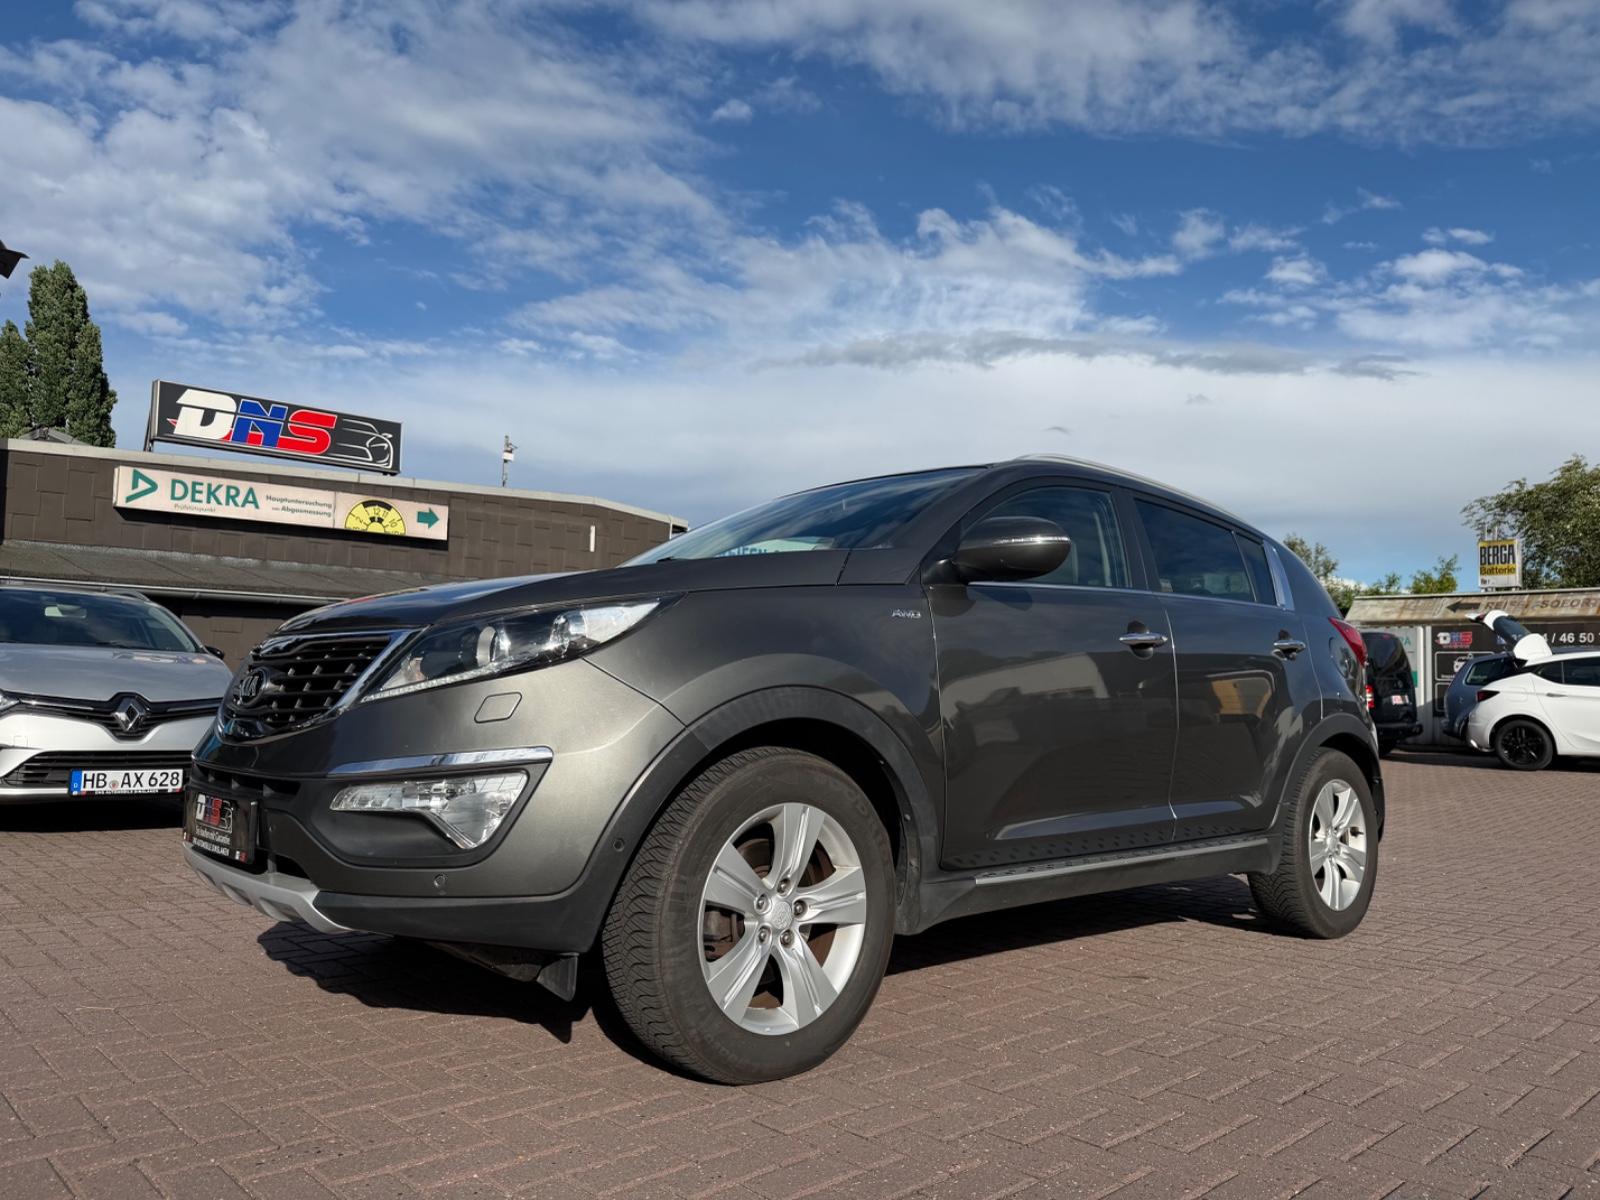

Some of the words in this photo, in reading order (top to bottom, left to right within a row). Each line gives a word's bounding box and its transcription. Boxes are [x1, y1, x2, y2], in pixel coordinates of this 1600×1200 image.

[173, 388, 338, 455] DNS
[170, 479, 260, 510] DEKRA
[1480, 544, 1516, 565] BERGA
[1480, 566, 1516, 576] Batterie
[891, 609, 921, 619] AWD
[1437, 631, 1473, 645] DNS
[1559, 633, 1575, 643] 46
[1579, 633, 1595, 643] 50
[83, 773, 107, 789] HB
[121, 772, 144, 788] AX
[148, 772, 180, 787] 628
